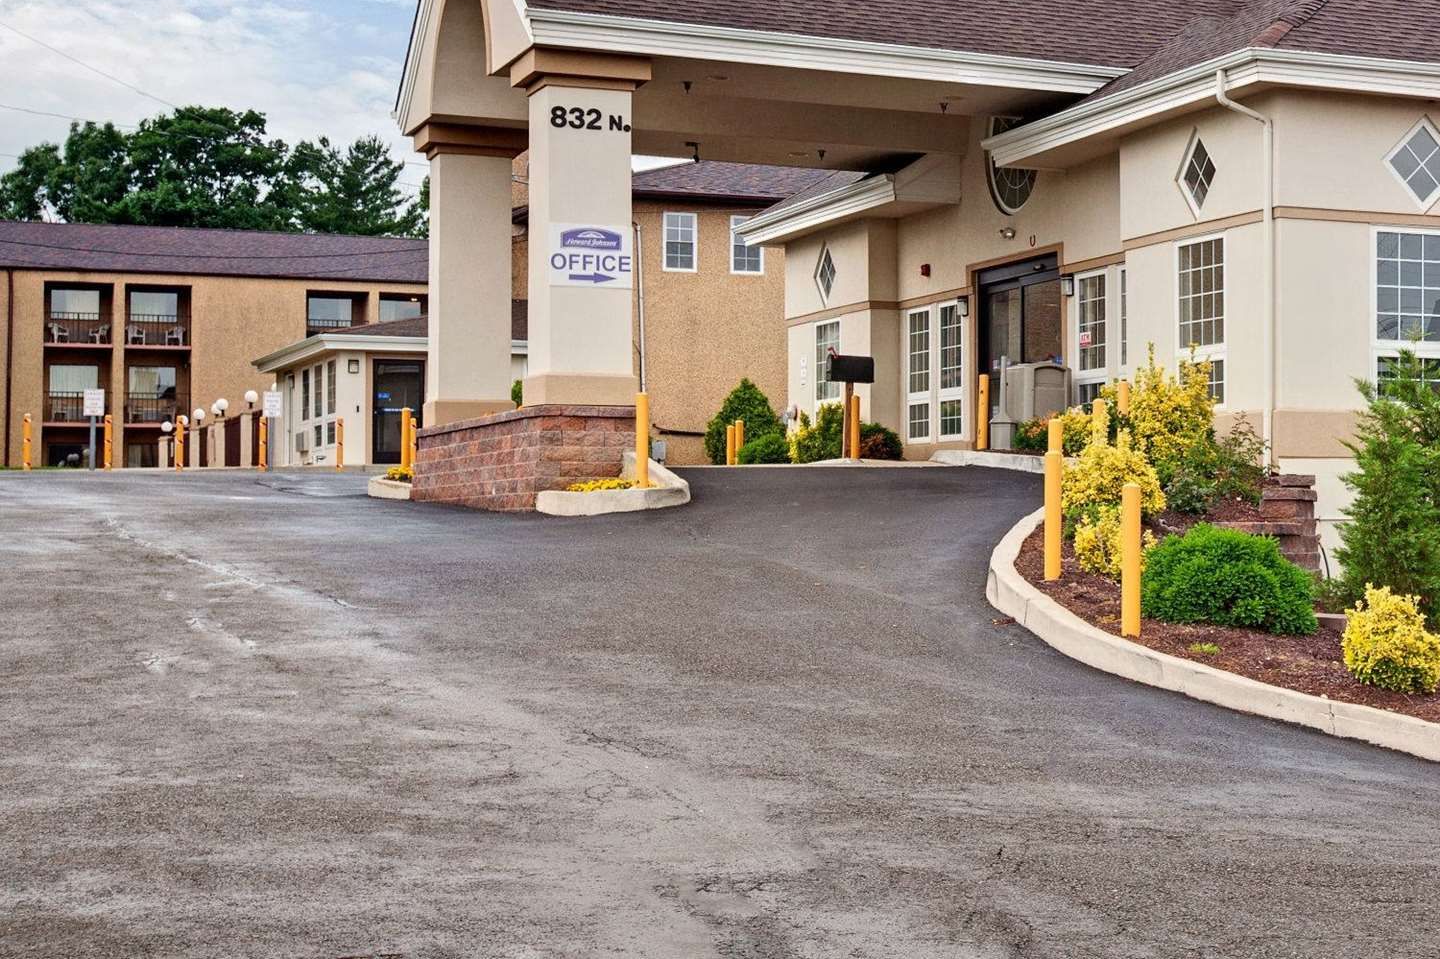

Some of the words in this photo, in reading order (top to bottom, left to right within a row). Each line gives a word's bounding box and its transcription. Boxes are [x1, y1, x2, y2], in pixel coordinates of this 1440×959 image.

[551, 106, 602, 130] 832
[609, 115, 631, 132] N.
[551, 253, 631, 272] OFFICE
